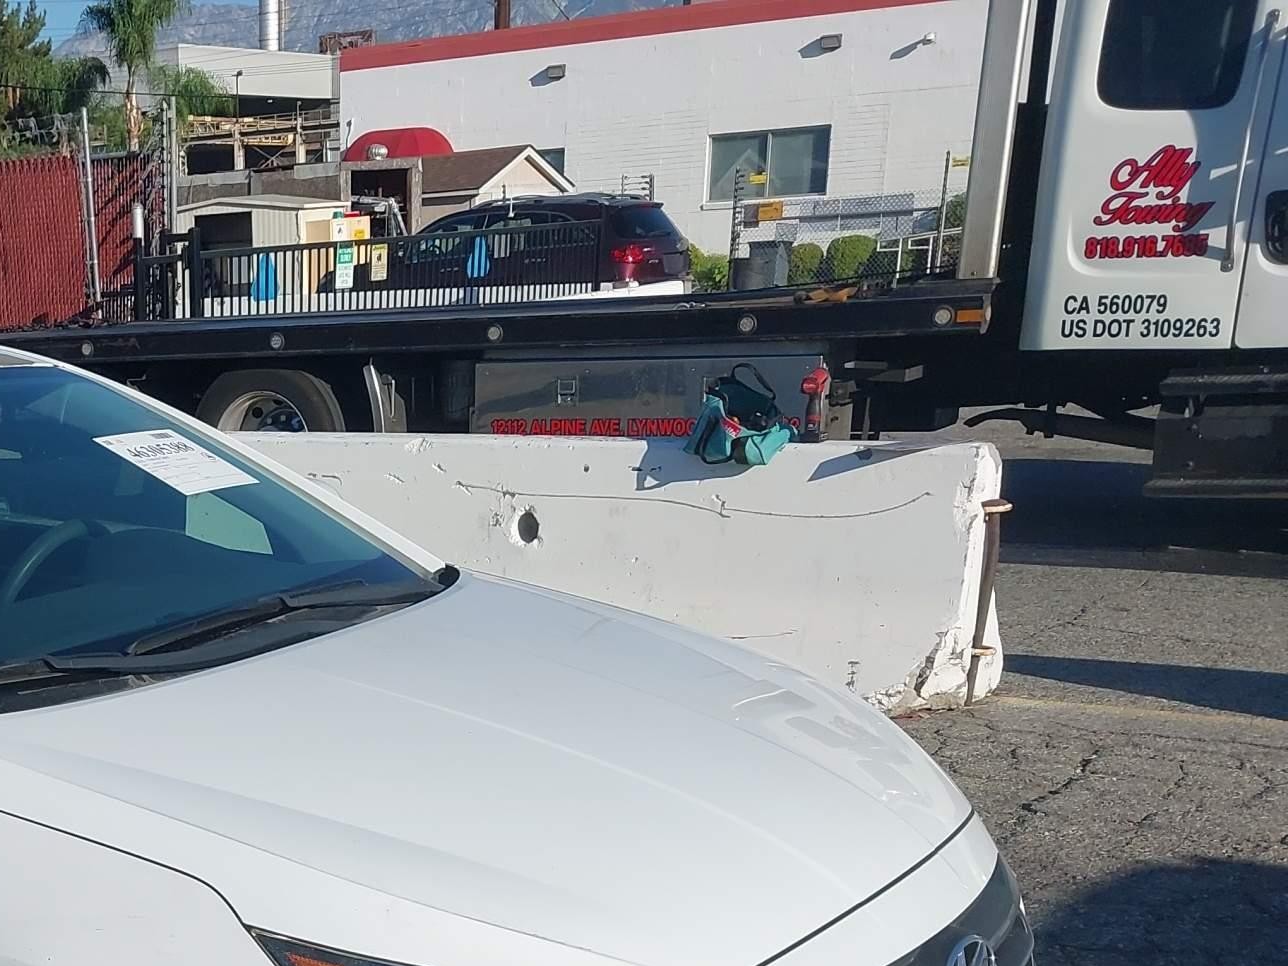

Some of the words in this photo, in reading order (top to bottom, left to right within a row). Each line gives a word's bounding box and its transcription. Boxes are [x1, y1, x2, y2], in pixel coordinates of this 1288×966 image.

[1110, 145, 1201, 201] Ally
[1093, 191, 1216, 232] Towing
[1064, 296, 1090, 314] CA
[1097, 295, 1167, 315] 560079
[1061, 319, 1087, 337] US
[1093, 319, 1135, 337] DOT
[1140, 318, 1220, 338] 3109263
[492, 420, 527, 435] 12112
[530, 419, 587, 435] ALPINE
[628, 418, 697, 436] LYNWOO
